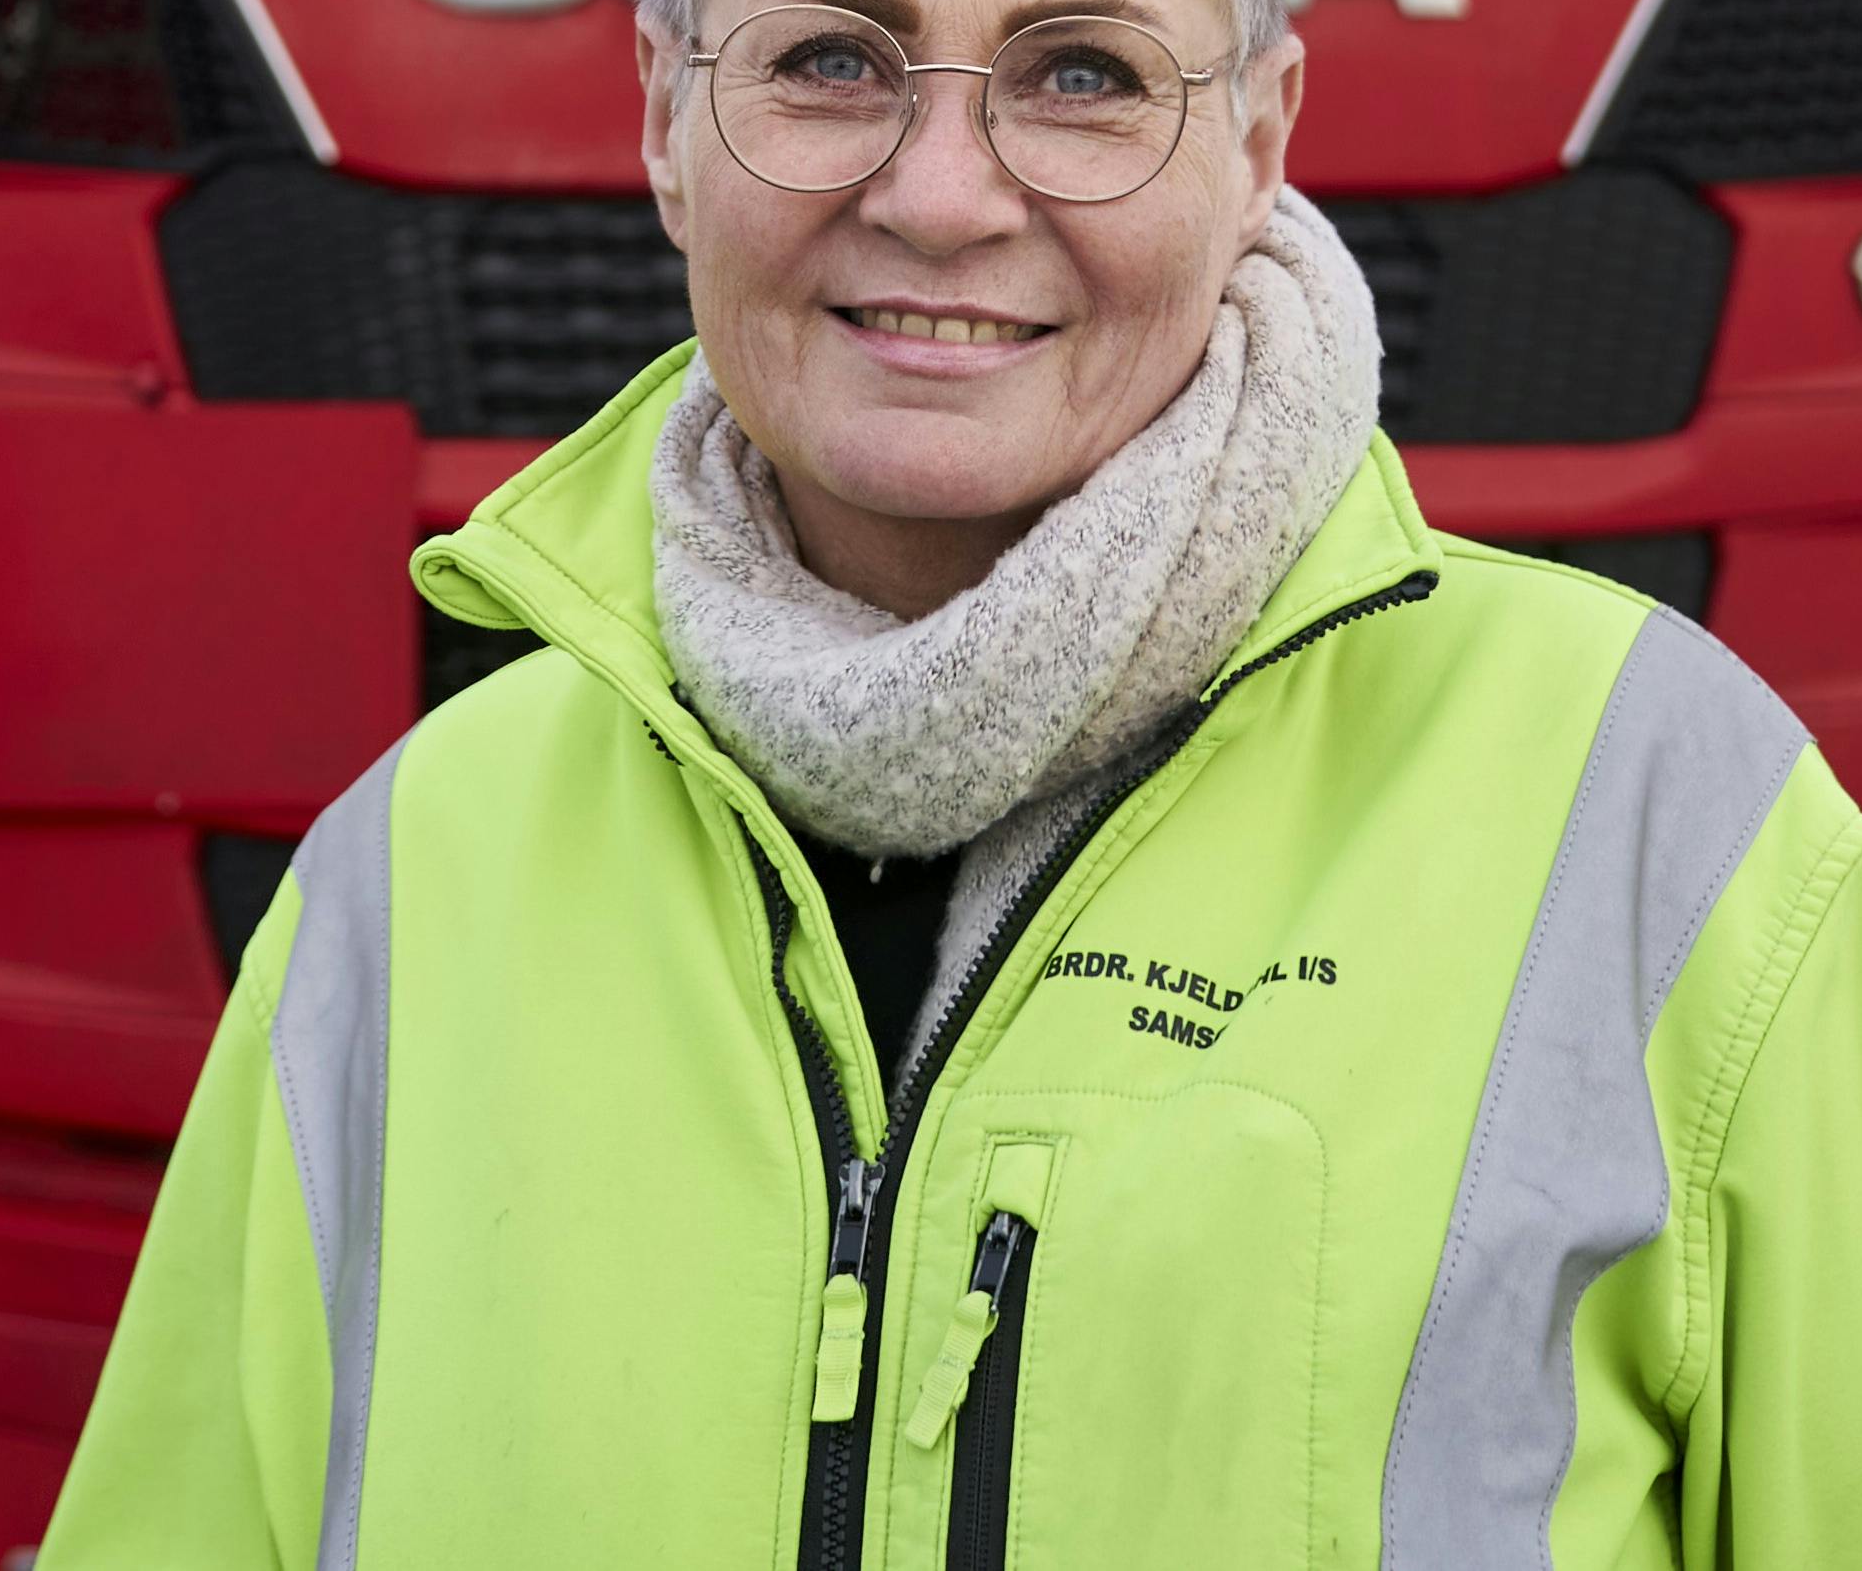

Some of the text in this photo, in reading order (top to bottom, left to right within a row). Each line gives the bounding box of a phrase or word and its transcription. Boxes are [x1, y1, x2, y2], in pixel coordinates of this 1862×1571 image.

[1044, 952, 1337, 1011] BRDR. KJELDL I/S
[1128, 1006, 1228, 1049] SAMS
